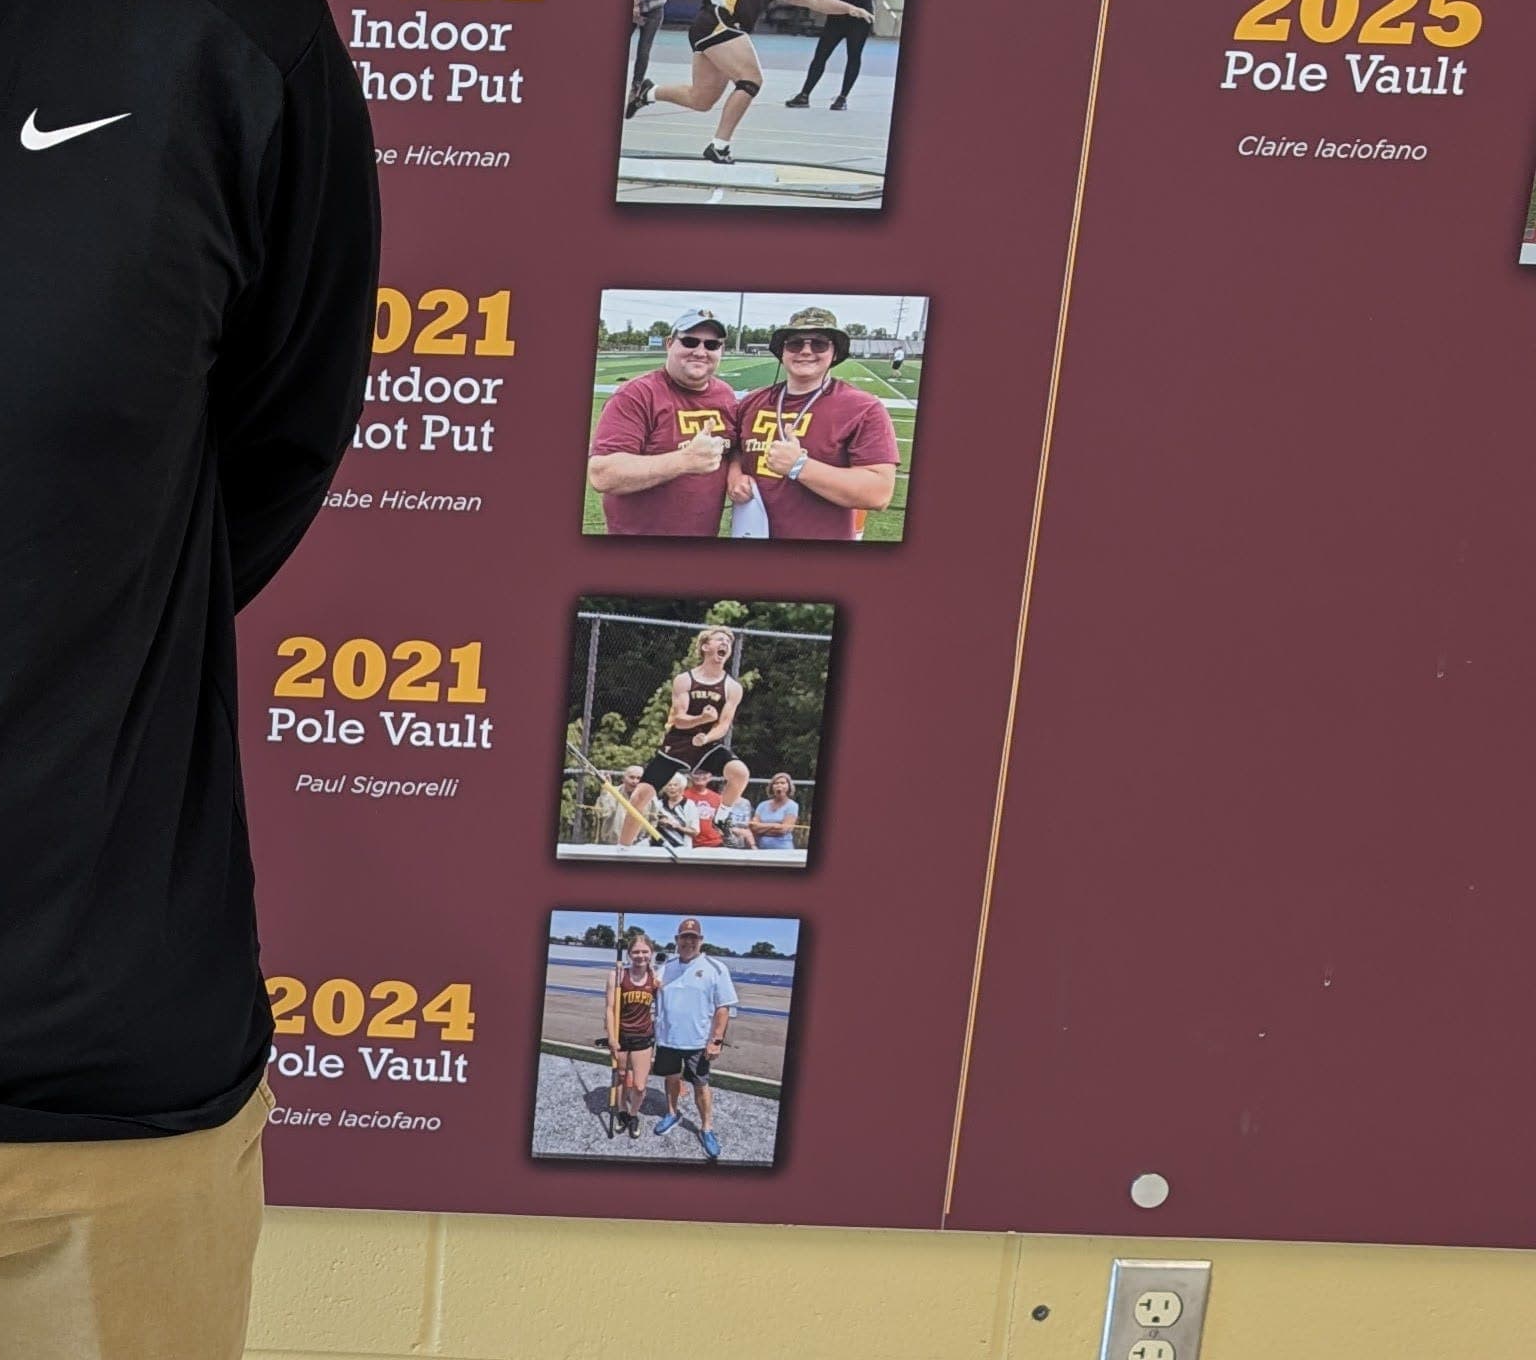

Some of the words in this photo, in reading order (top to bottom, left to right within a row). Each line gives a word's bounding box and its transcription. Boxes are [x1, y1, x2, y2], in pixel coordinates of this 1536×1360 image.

[350, 9, 512, 52] Indoor
[352, 62, 434, 102] hot
[446, 64, 523, 104] Put
[1221, 50, 1327, 93] Pole
[1345, 53, 1467, 96] Vault
[372, 146, 398, 166] be
[404, 146, 510, 168] Hickman
[1238, 135, 1308, 158] Claire
[1315, 138, 1427, 161] Iaciofano
[371, 286, 514, 357] 021
[420, 416, 494, 453] Put
[379, 491, 481, 512] Hickman
[274, 637, 487, 704] 2021
[267, 707, 365, 746] Pole
[380, 711, 493, 749] Vault
[296, 774, 345, 793] Paul
[351, 776, 458, 800] Signorelli
[265, 976, 476, 1042] 2024
[358, 1047, 469, 1084] Vault
[268, 1106, 332, 1129] Claire
[339, 1109, 442, 1132] Iaciofano
